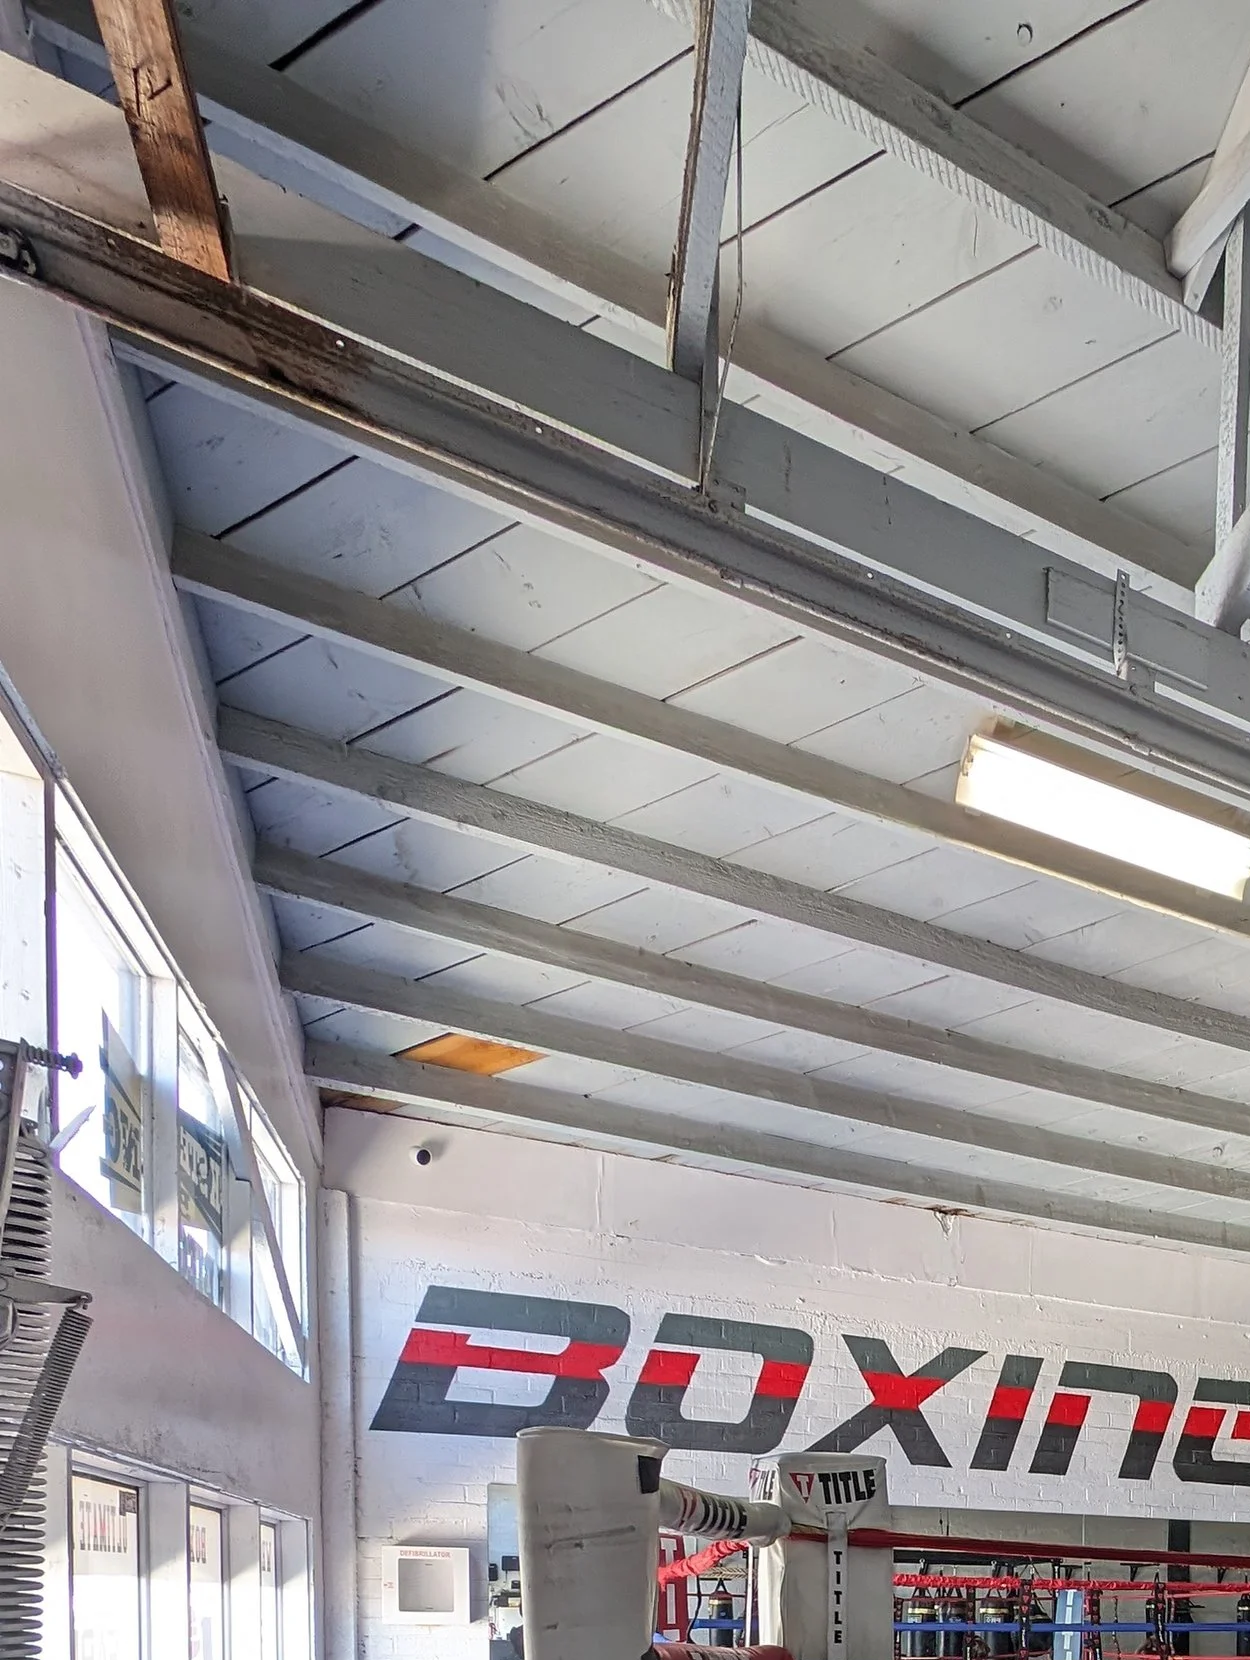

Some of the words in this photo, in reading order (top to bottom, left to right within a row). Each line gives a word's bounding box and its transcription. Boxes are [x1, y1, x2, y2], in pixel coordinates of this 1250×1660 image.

[818, 1469, 877, 1505] TITLE
[400, 1549, 451, 1558] DEFIBRILLATOR
[832, 1551, 842, 1644] TITLE
